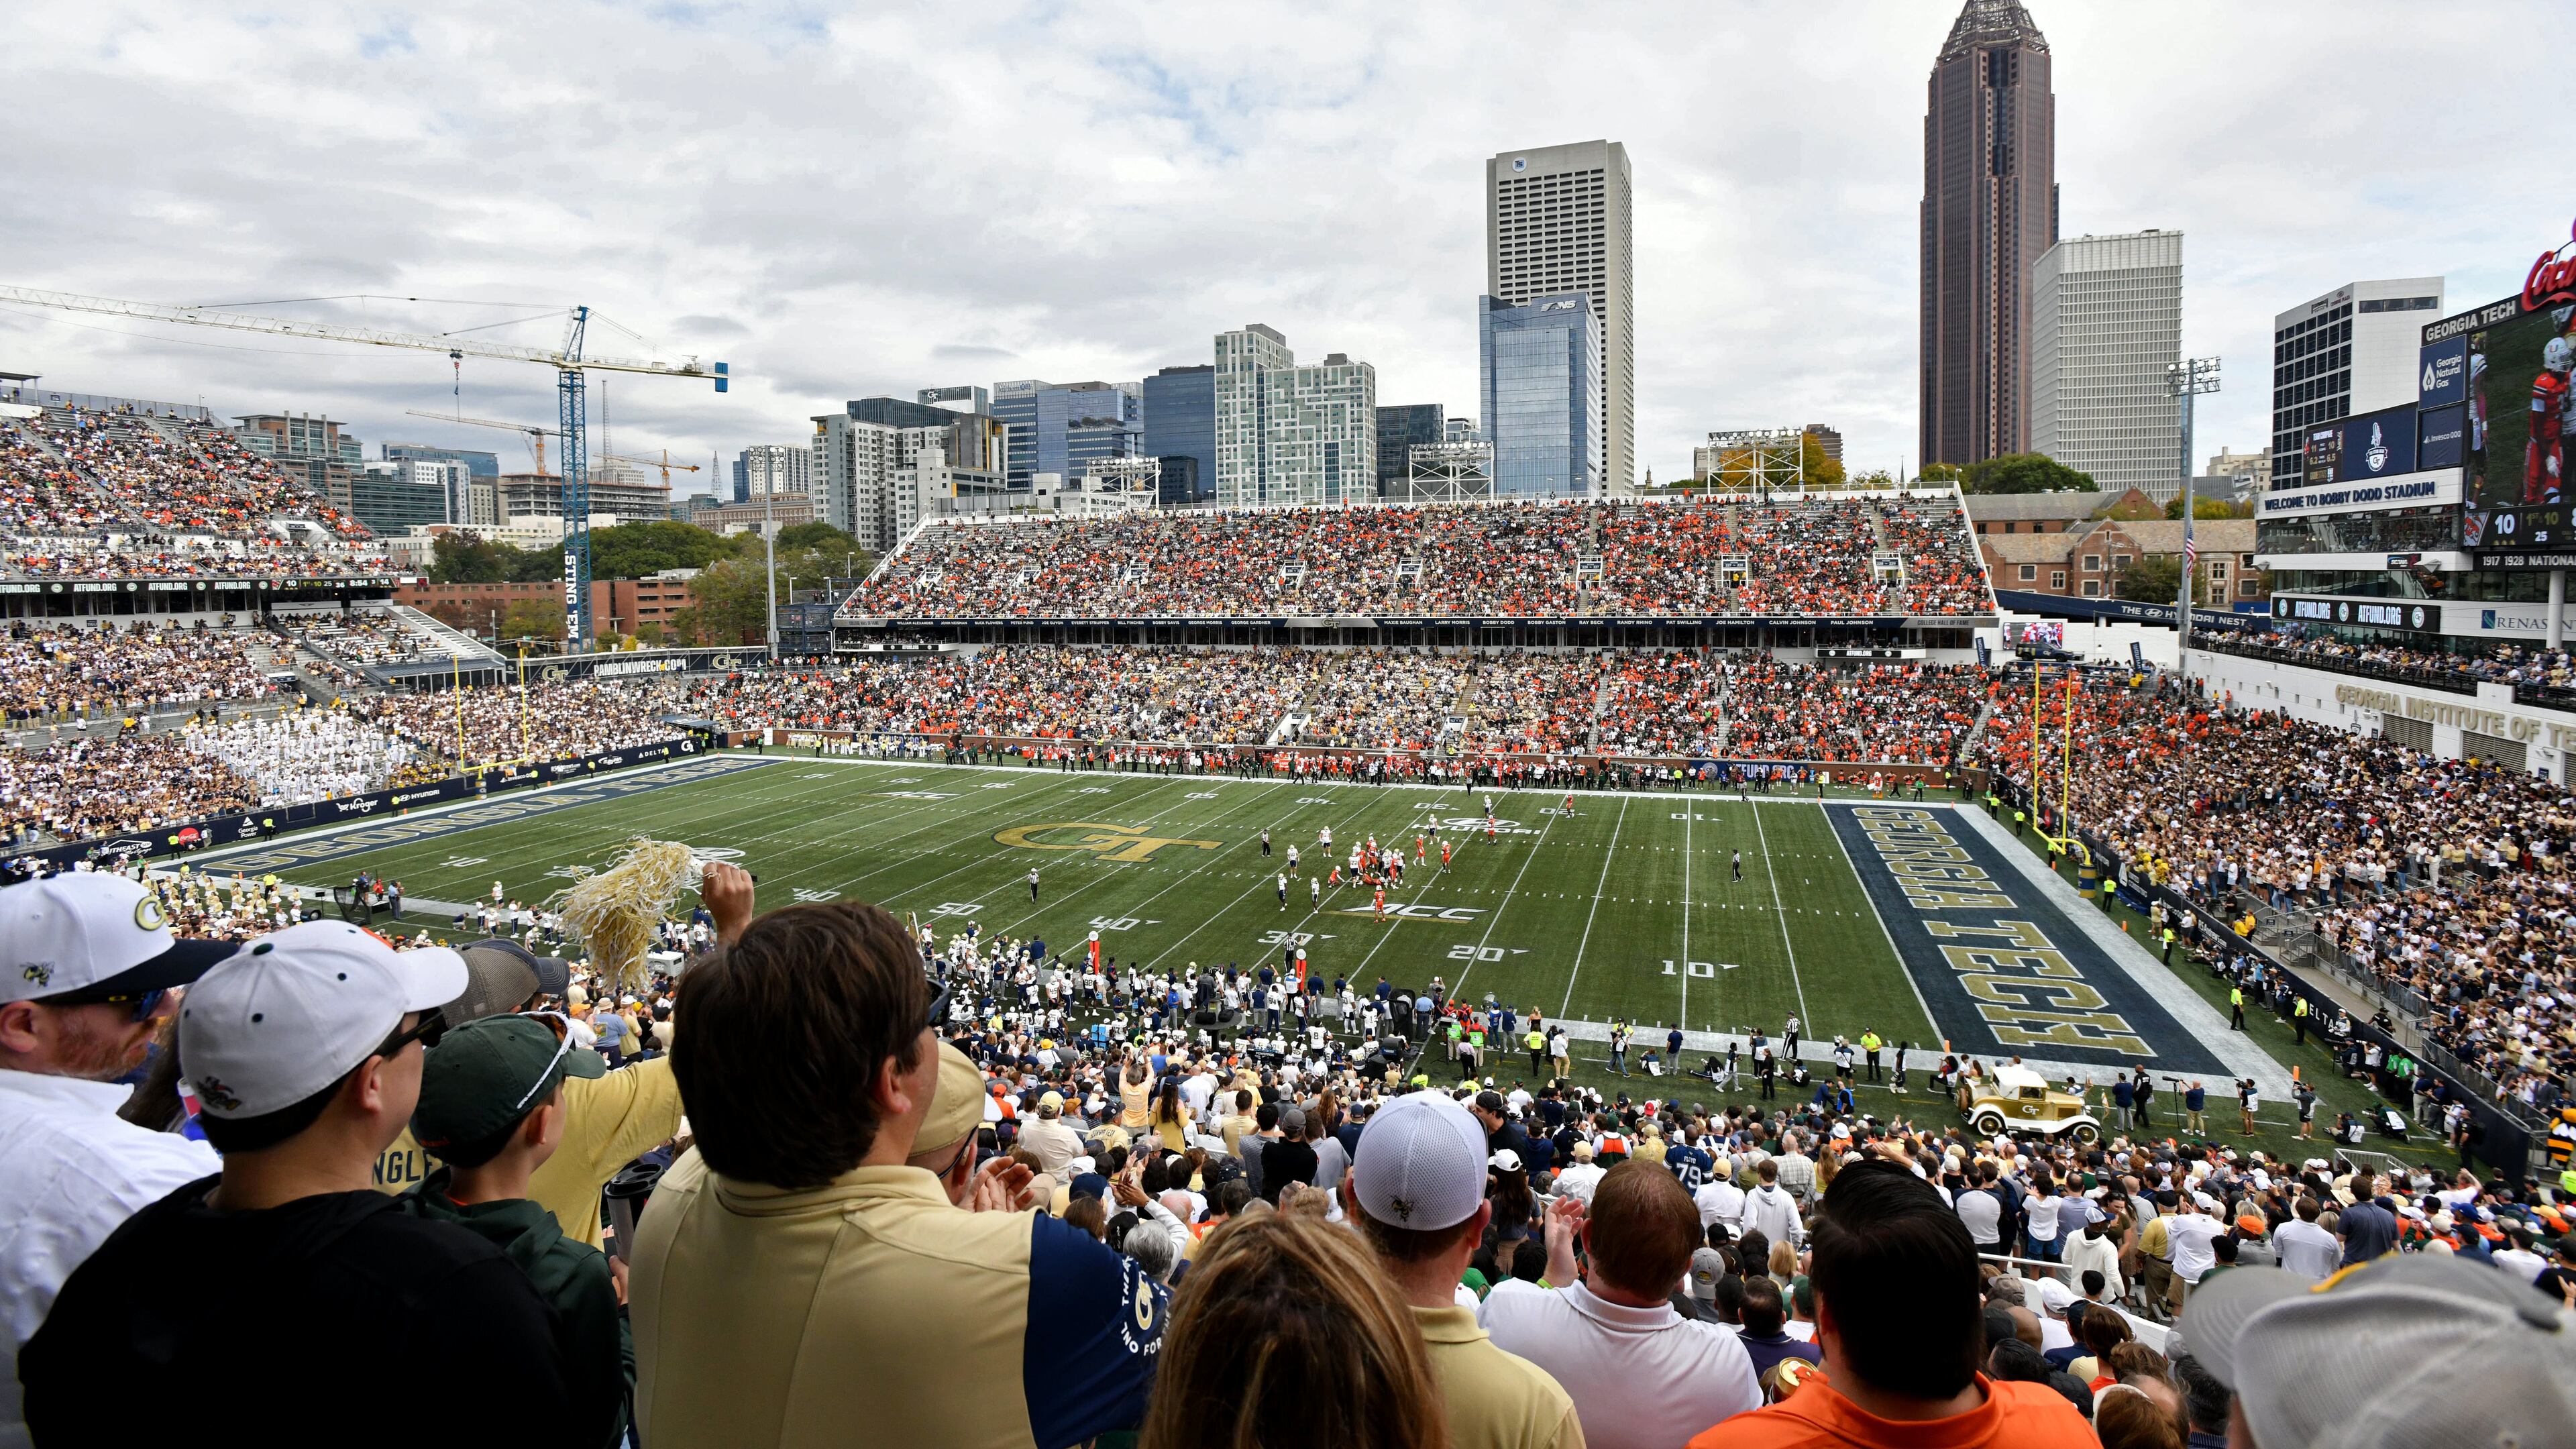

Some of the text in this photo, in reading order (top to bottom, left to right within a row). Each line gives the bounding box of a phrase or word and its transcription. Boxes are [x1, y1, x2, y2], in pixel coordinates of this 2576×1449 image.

[2426, 300, 2516, 341] GEORGIA TECH
[2436, 354, 2462, 368] Georgia
[2436, 364, 2461, 378] Natural
[2436, 378, 2449, 388] Gas
[2431, 431, 2461, 442] Invesco QQQ
[2326, 453, 2336, 462] 6.5
[2265, 481, 2435, 511] WELCOME TO BOBBY DODD STADIUM
[2494, 514, 2515, 535] 10
[2544, 511, 2559, 525] 10
[2534, 531, 2548, 542] 25
[2483, 555, 2576, 566] 1917 1928 NATIONA
[73, 582, 117, 592] ATFUND.ORG
[148, 582, 188, 591] ATFUND.ORG
[215, 582, 251, 590] ATFUND.ORG
[565, 555, 578, 604] STING
[2121, 606, 2142, 615] THE
[2218, 616, 2247, 627] NEST
[2294, 600, 2402, 626] ATFUND.ORG ATFUND.ORG
[1322, 617, 1340, 629] GT
[2497, 616, 2576, 631] RENASN
[594, 658, 686, 678] RAMBLINWRECKCOM
[712, 654, 742, 672] GT
[541, 665, 568, 683] GT
[2335, 683, 2402, 716] GEORGIA
[2406, 696, 2506, 737] INSTITUTE
[2510, 716, 2541, 743] OF
[644, 746, 665, 758] DELTA
[578, 759, 766, 792] TECH
[411, 789, 440, 800] HYUNDAI
[350, 798, 378, 813] Kroger
[200, 794, 604, 871] GEORGIA
[238, 825, 258, 834] Georgia
[991, 822, 1228, 863] GT
[439, 857, 488, 867] 10
[1850, 807, 2019, 910] GEORGIA
[794, 889, 842, 902] 40
[929, 902, 983, 916] 50
[1342, 903, 1489, 921] ACC
[1088, 916, 1140, 931] 40
[1257, 930, 1314, 947] 30
[1446, 945, 1505, 962] 20
[1662, 959, 1715, 978] 10
[1922, 920, 2159, 1058] TECH
[2309, 1003, 2334, 1029] ELTA
[983, 1049, 990, 1061] 0
[2023, 1105, 2040, 1115] GT
[1683, 1155, 1697, 1164] FLOYD
[1676, 1163, 1702, 1190] 79
[1144, 1337, 1162, 1356] FOR
